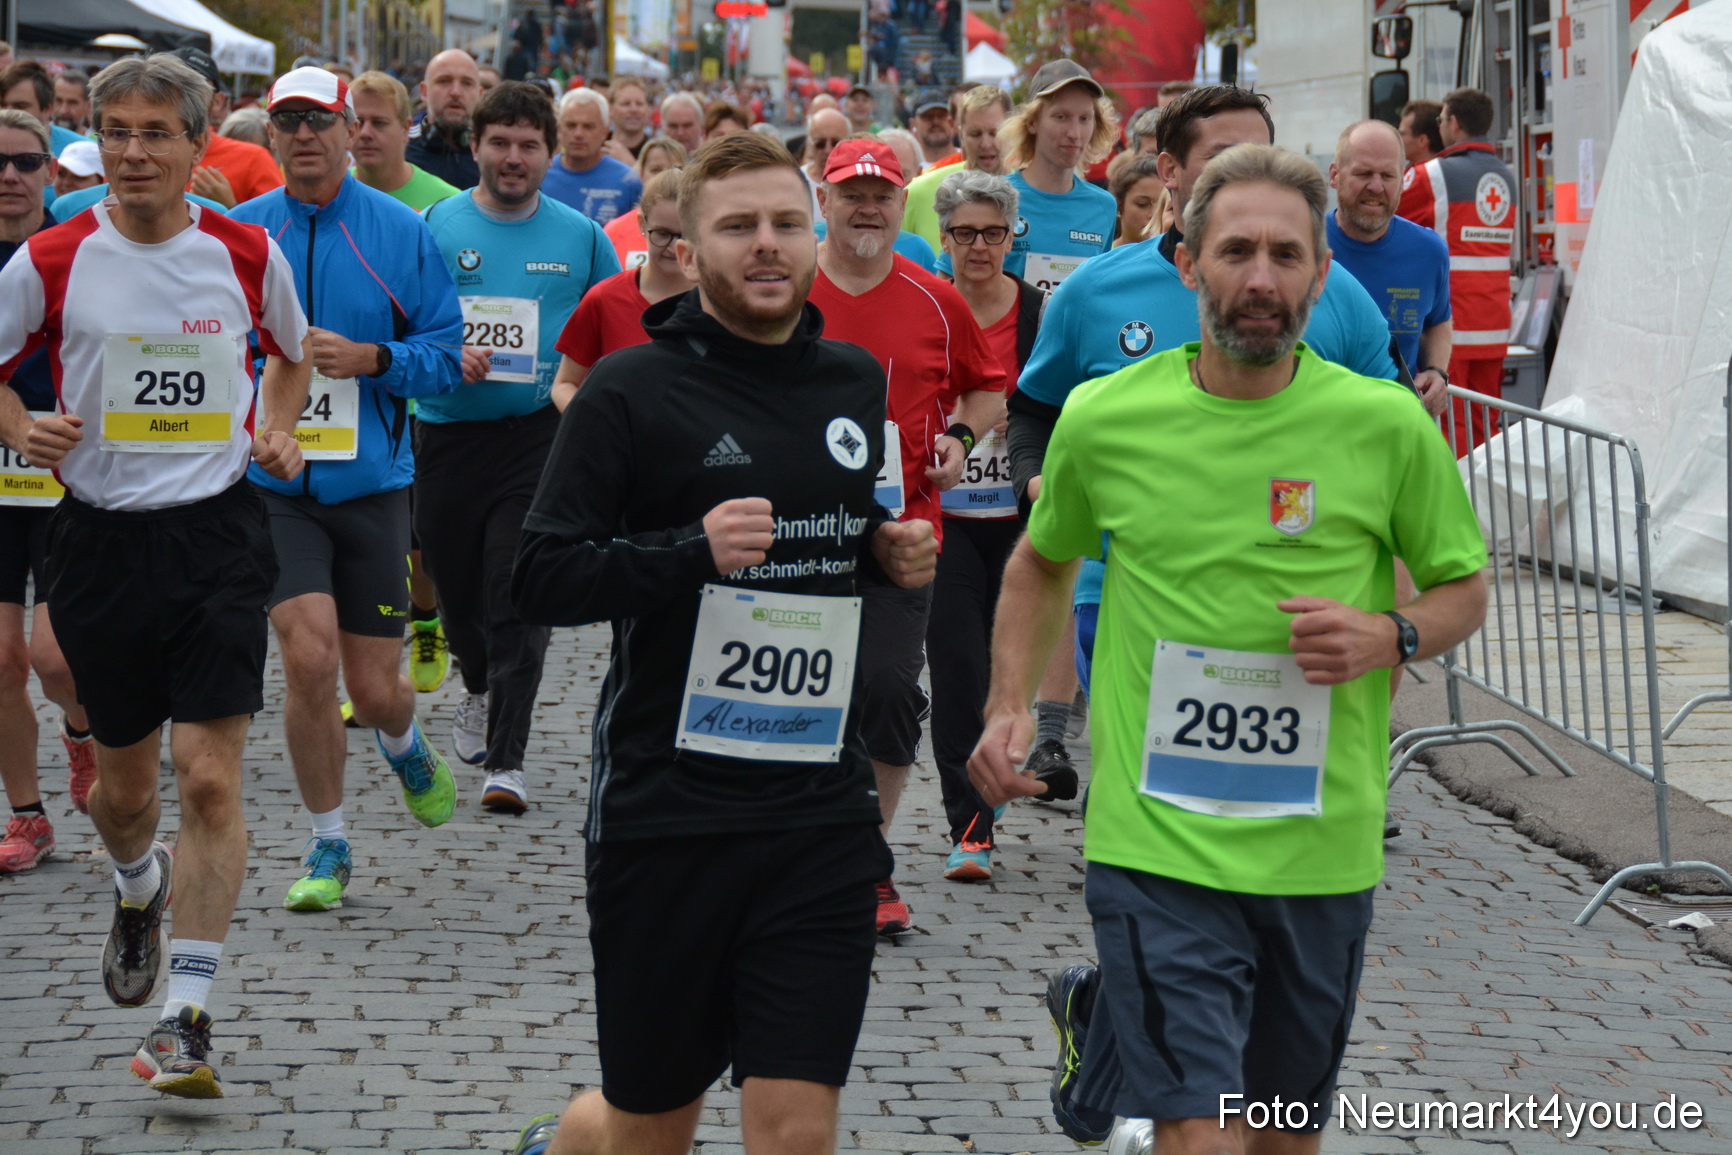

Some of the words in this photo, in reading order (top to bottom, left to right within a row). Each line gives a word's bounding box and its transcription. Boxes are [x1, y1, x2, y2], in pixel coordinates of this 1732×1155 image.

[1069, 230, 1103, 243] BOCK
[525, 262, 570, 274] BOCK
[182, 320, 222, 334] MID
[463, 322, 524, 349] 2283
[155, 345, 200, 355] BOCK
[488, 356, 511, 366] stian
[134, 370, 206, 406] 259
[299, 393, 332, 421] 24
[149, 419, 189, 432] Albert
[703, 454, 752, 466] adidas
[960, 455, 1012, 484] 543
[4, 478, 44, 489] Martina
[969, 492, 1000, 504] Margit
[769, 609, 822, 626] BOCK
[715, 640, 833, 697] 2909
[1220, 666, 1281, 683] BOCK
[692, 700, 822, 735] Alexander
[1172, 697, 1300, 755] 2933
